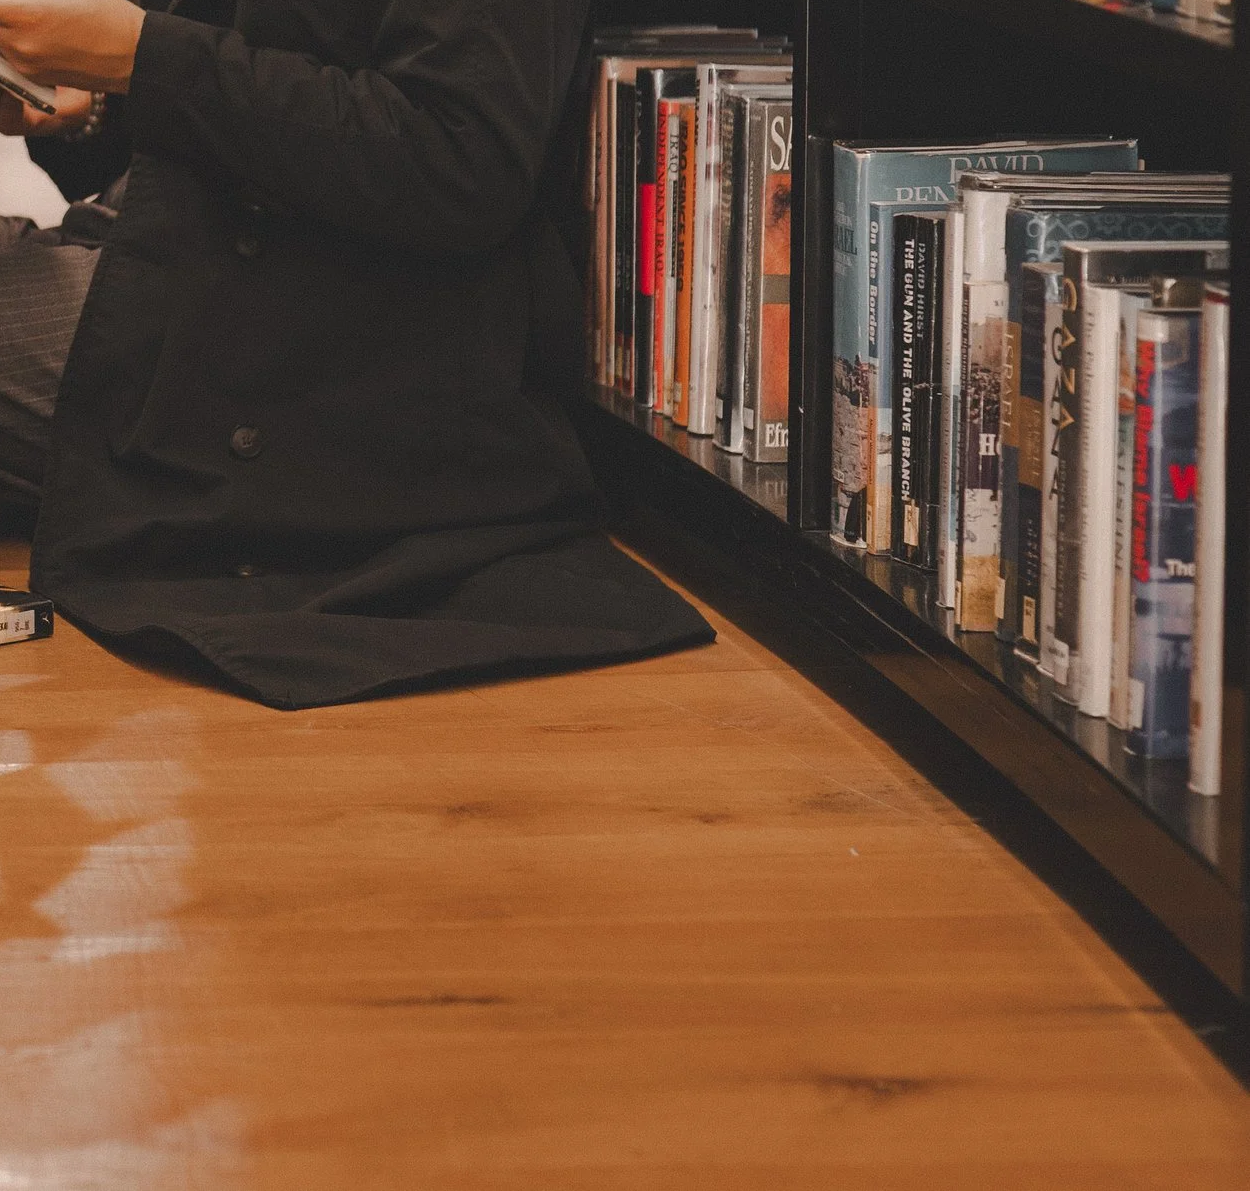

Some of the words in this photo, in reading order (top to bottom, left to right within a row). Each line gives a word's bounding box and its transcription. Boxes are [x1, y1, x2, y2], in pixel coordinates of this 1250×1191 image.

[655, 113, 667, 226] INDEPENDENT
[668, 133, 679, 174] IRAQ
[678, 120, 689, 171] IRAQ
[949, 154, 1044, 185] DAVID
[677, 174, 687, 236] SINCE
[869, 221, 879, 245] On
[904, 238, 915, 270] THE
[869, 250, 879, 279] the
[916, 242, 926, 290] DAVID
[903, 272, 914, 307] GUN
[869, 284, 879, 347] Border
[903, 308, 914, 344] AND
[916, 294, 925, 341] HIRST
[902, 347, 913, 379] THE
[1059, 276, 1078, 432] GAZA
[1136, 341, 1157, 398] Why
[1002, 333, 1015, 429] ISRAEL
[901, 386, 912, 432] OLIVE
[900, 435, 912, 502] BRANCH
[1133, 405, 1154, 487] Blame
[1131, 491, 1153, 584] Israel?
